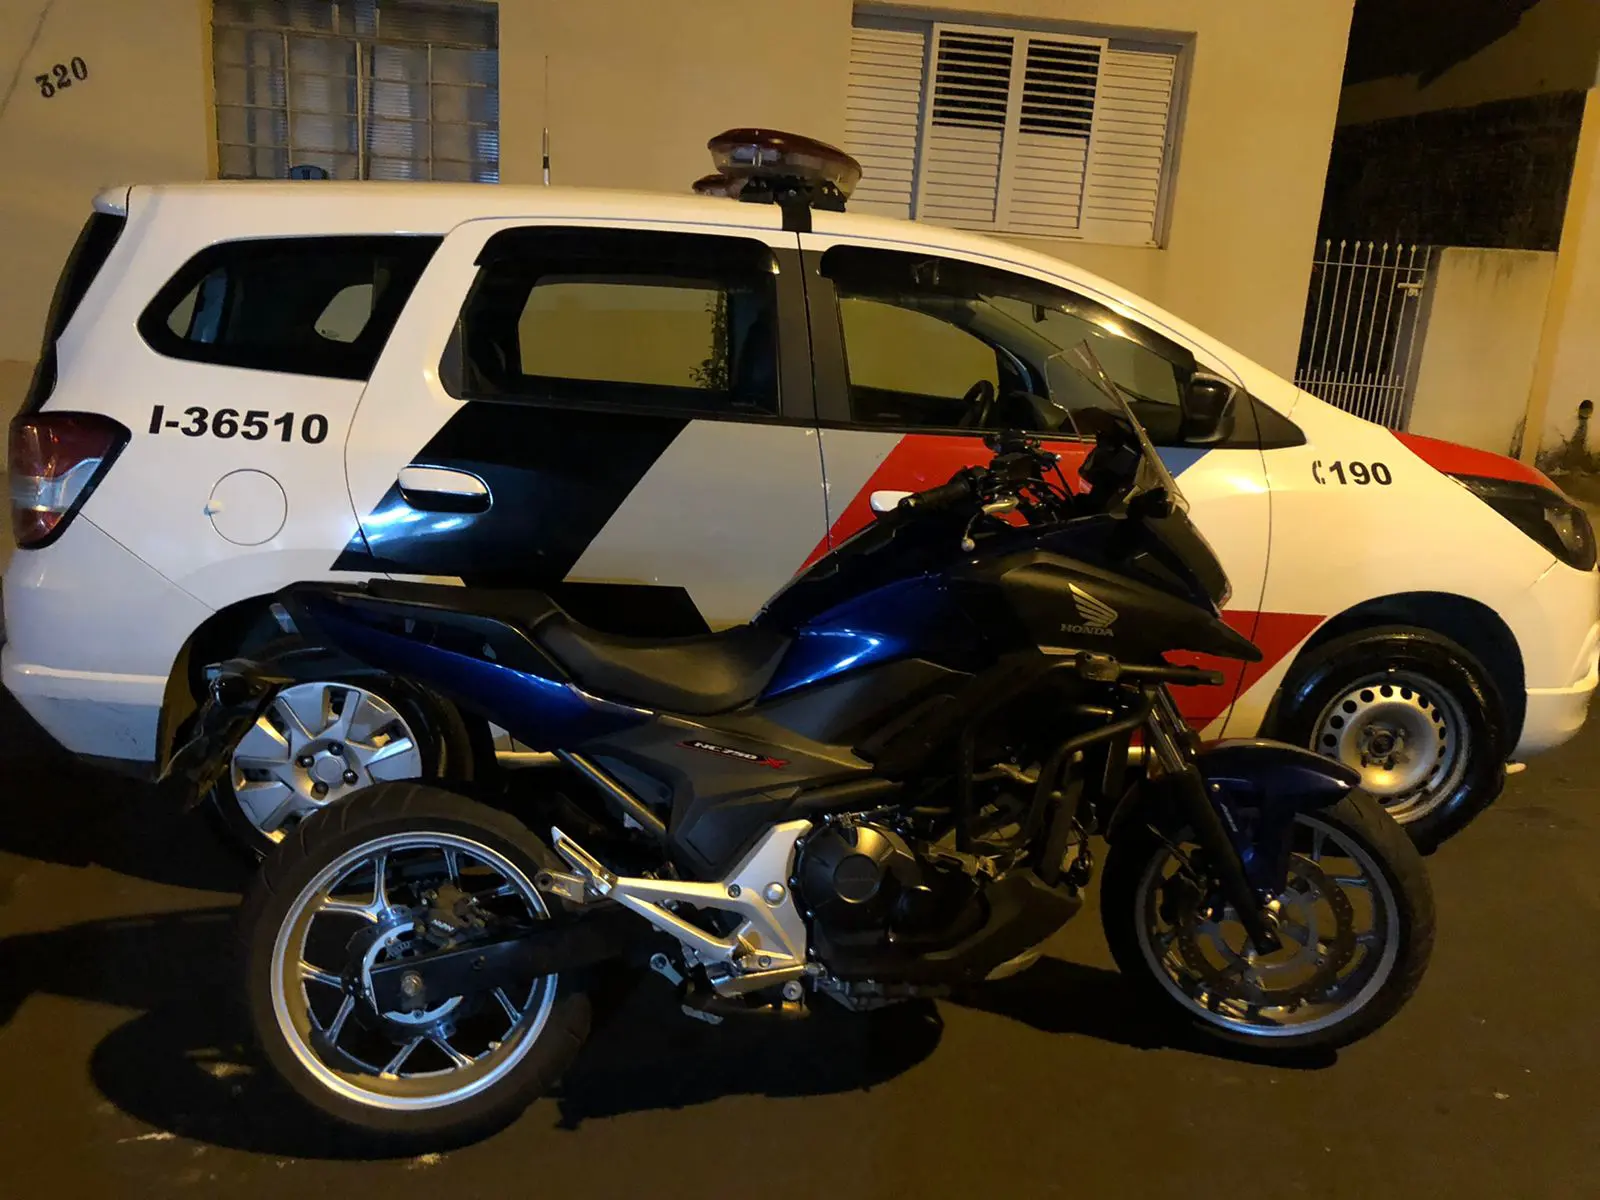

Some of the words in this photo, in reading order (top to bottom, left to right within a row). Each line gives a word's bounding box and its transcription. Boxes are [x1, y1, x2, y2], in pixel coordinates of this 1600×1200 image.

[35, 56, 88, 98] 320
[148, 405, 329, 444] I-36510
[1329, 460, 1393, 486] 190
[1060, 623, 1115, 637] HONDA
